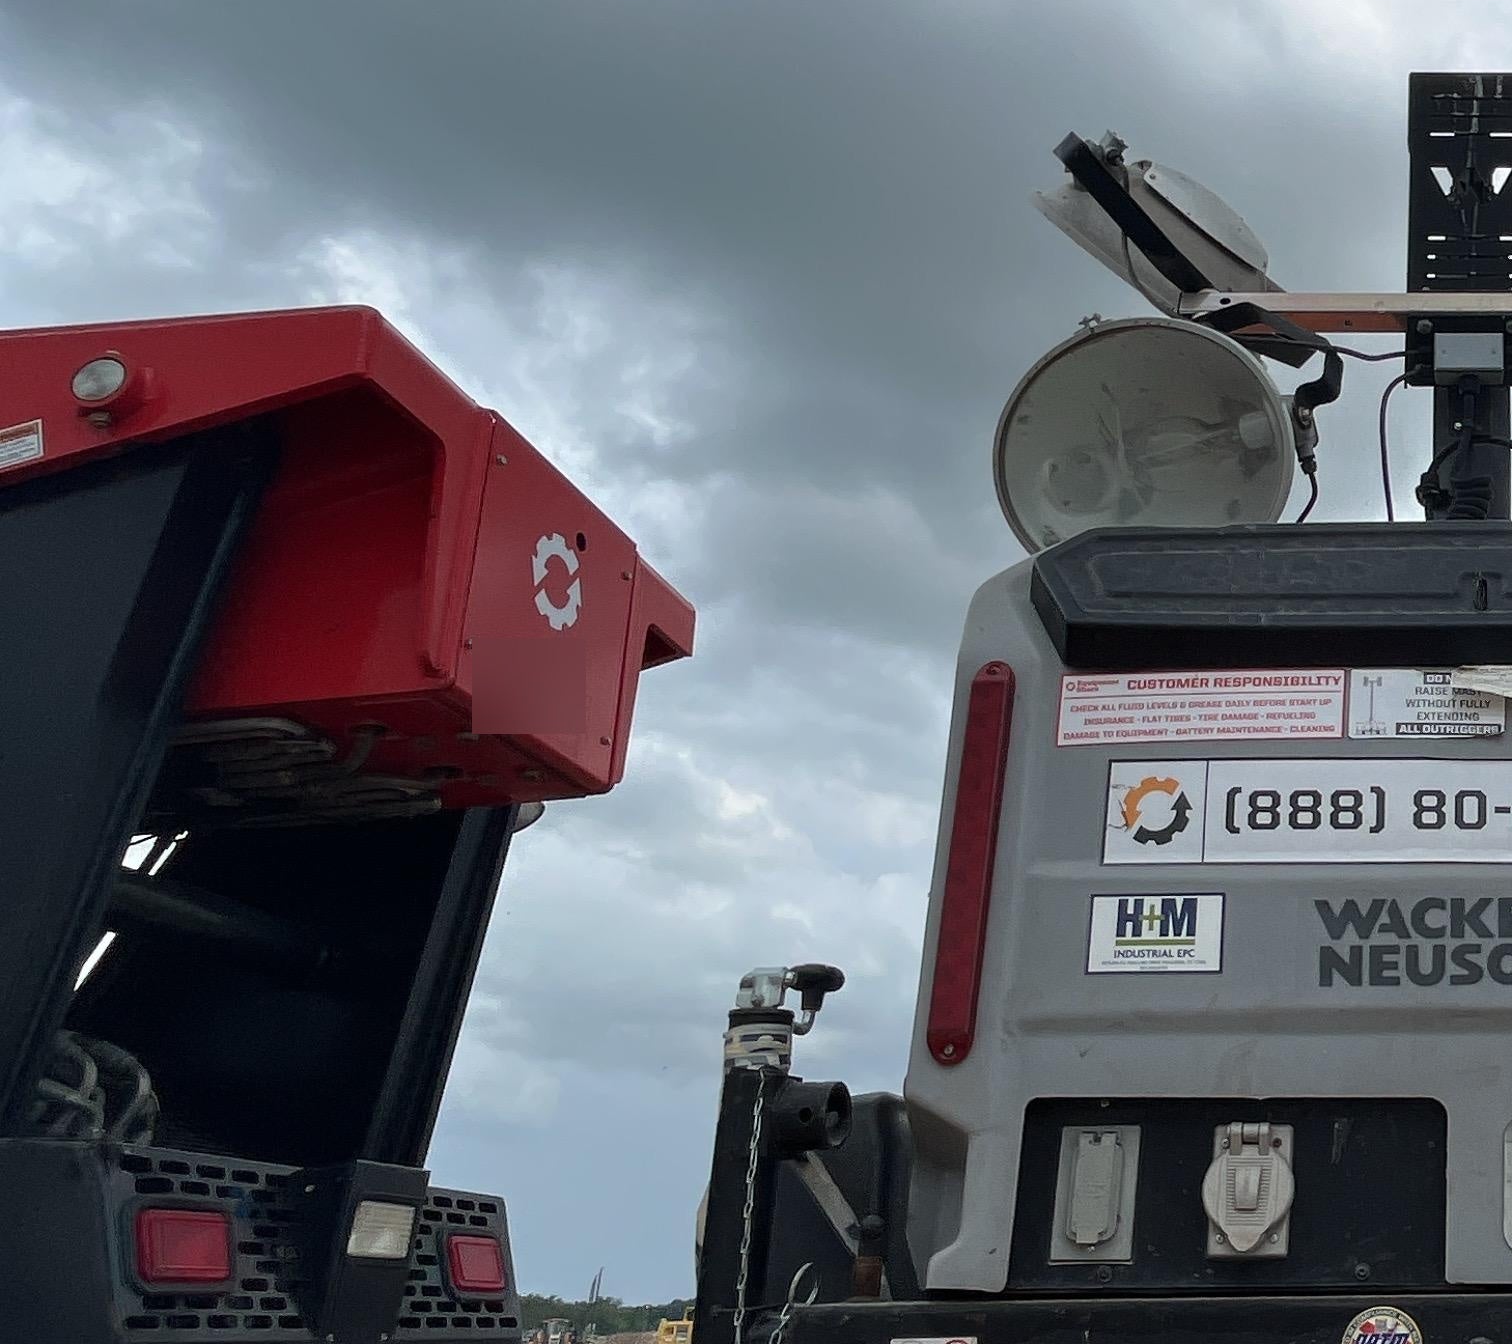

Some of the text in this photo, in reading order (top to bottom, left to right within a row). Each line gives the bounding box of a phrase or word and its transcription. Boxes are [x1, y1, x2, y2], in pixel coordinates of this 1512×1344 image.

[1127, 675, 1342, 691] CUSTOMER RESPONSIBILITY
[1415, 686, 1449, 696] RAISE
[1101, 704, 1116, 712] ALL
[1225, 699, 1251, 708] DAILY
[1319, 698, 1333, 706] UP
[1405, 699, 1492, 709] WITHOUT FULLY
[1141, 715, 1164, 724] FLAT
[1416, 712, 1480, 722] EXTENDING
[1102, 730, 1114, 738] TO
[1399, 724, 1499, 735] ALL OUTRIGGERS
[1224, 785, 1387, 835] (888)
[1115, 897, 1199, 938] H+M
[1113, 948, 1175, 959] INDUSTRIAL
